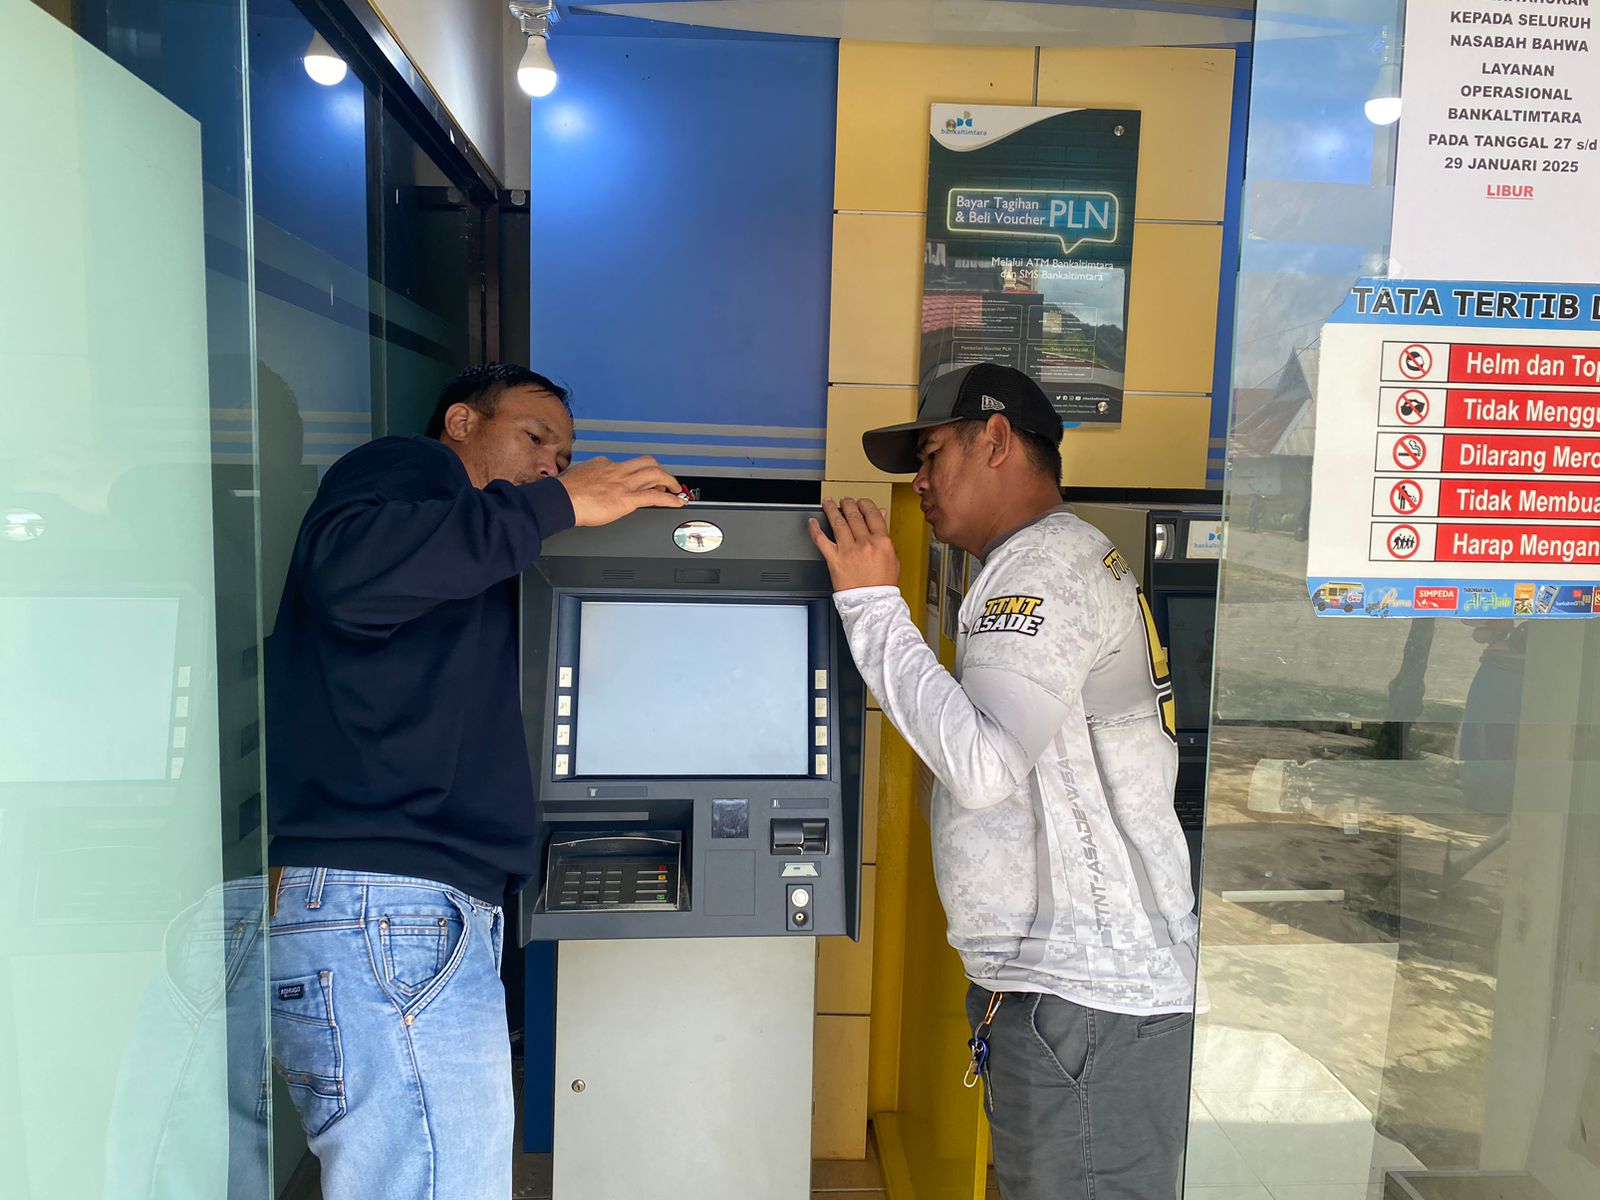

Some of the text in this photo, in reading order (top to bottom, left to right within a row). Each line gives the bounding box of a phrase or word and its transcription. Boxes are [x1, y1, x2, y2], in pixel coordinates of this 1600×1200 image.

[1450, 11, 1591, 29] KEPADA SELURUH
[1450, 34, 1589, 52] NASABAH BAHWA
[1481, 62, 1555, 77] LAYANAN
[1460, 85, 1573, 101] OPERASIONAL
[1448, 107, 1582, 124] BANKALTIMTARA
[940, 128, 987, 136] bankaltimtara
[1428, 133, 1598, 151] PADA TANGGAL 27 s/d
[1444, 157, 1579, 173] 29 JANUARI 2025
[1486, 184, 1534, 198] LIBUR
[956, 195, 1039, 212] Bayar Tagihan
[955, 211, 1045, 225] & Beli Voucher
[1049, 200, 1109, 230] PLN
[991, 257, 1023, 267] Melalui
[1026, 258, 1049, 268] ATM
[1052, 259, 1114, 270] Bankaltimtara
[1000, 269, 1103, 281] dan SMS Bankaltimtara
[1351, 286, 1443, 316] TATA
[1453, 290, 1580, 320] TERTIB
[1467, 351, 1520, 375] Helm
[1526, 353, 1565, 376] dan
[1463, 398, 1520, 421] Tidak
[1459, 443, 1546, 473] Dilarang
[1456, 488, 1512, 511] Tidak
[1453, 532, 1599, 562] Harap Mengan
[1418, 589, 1454, 598] SIMPEDA
